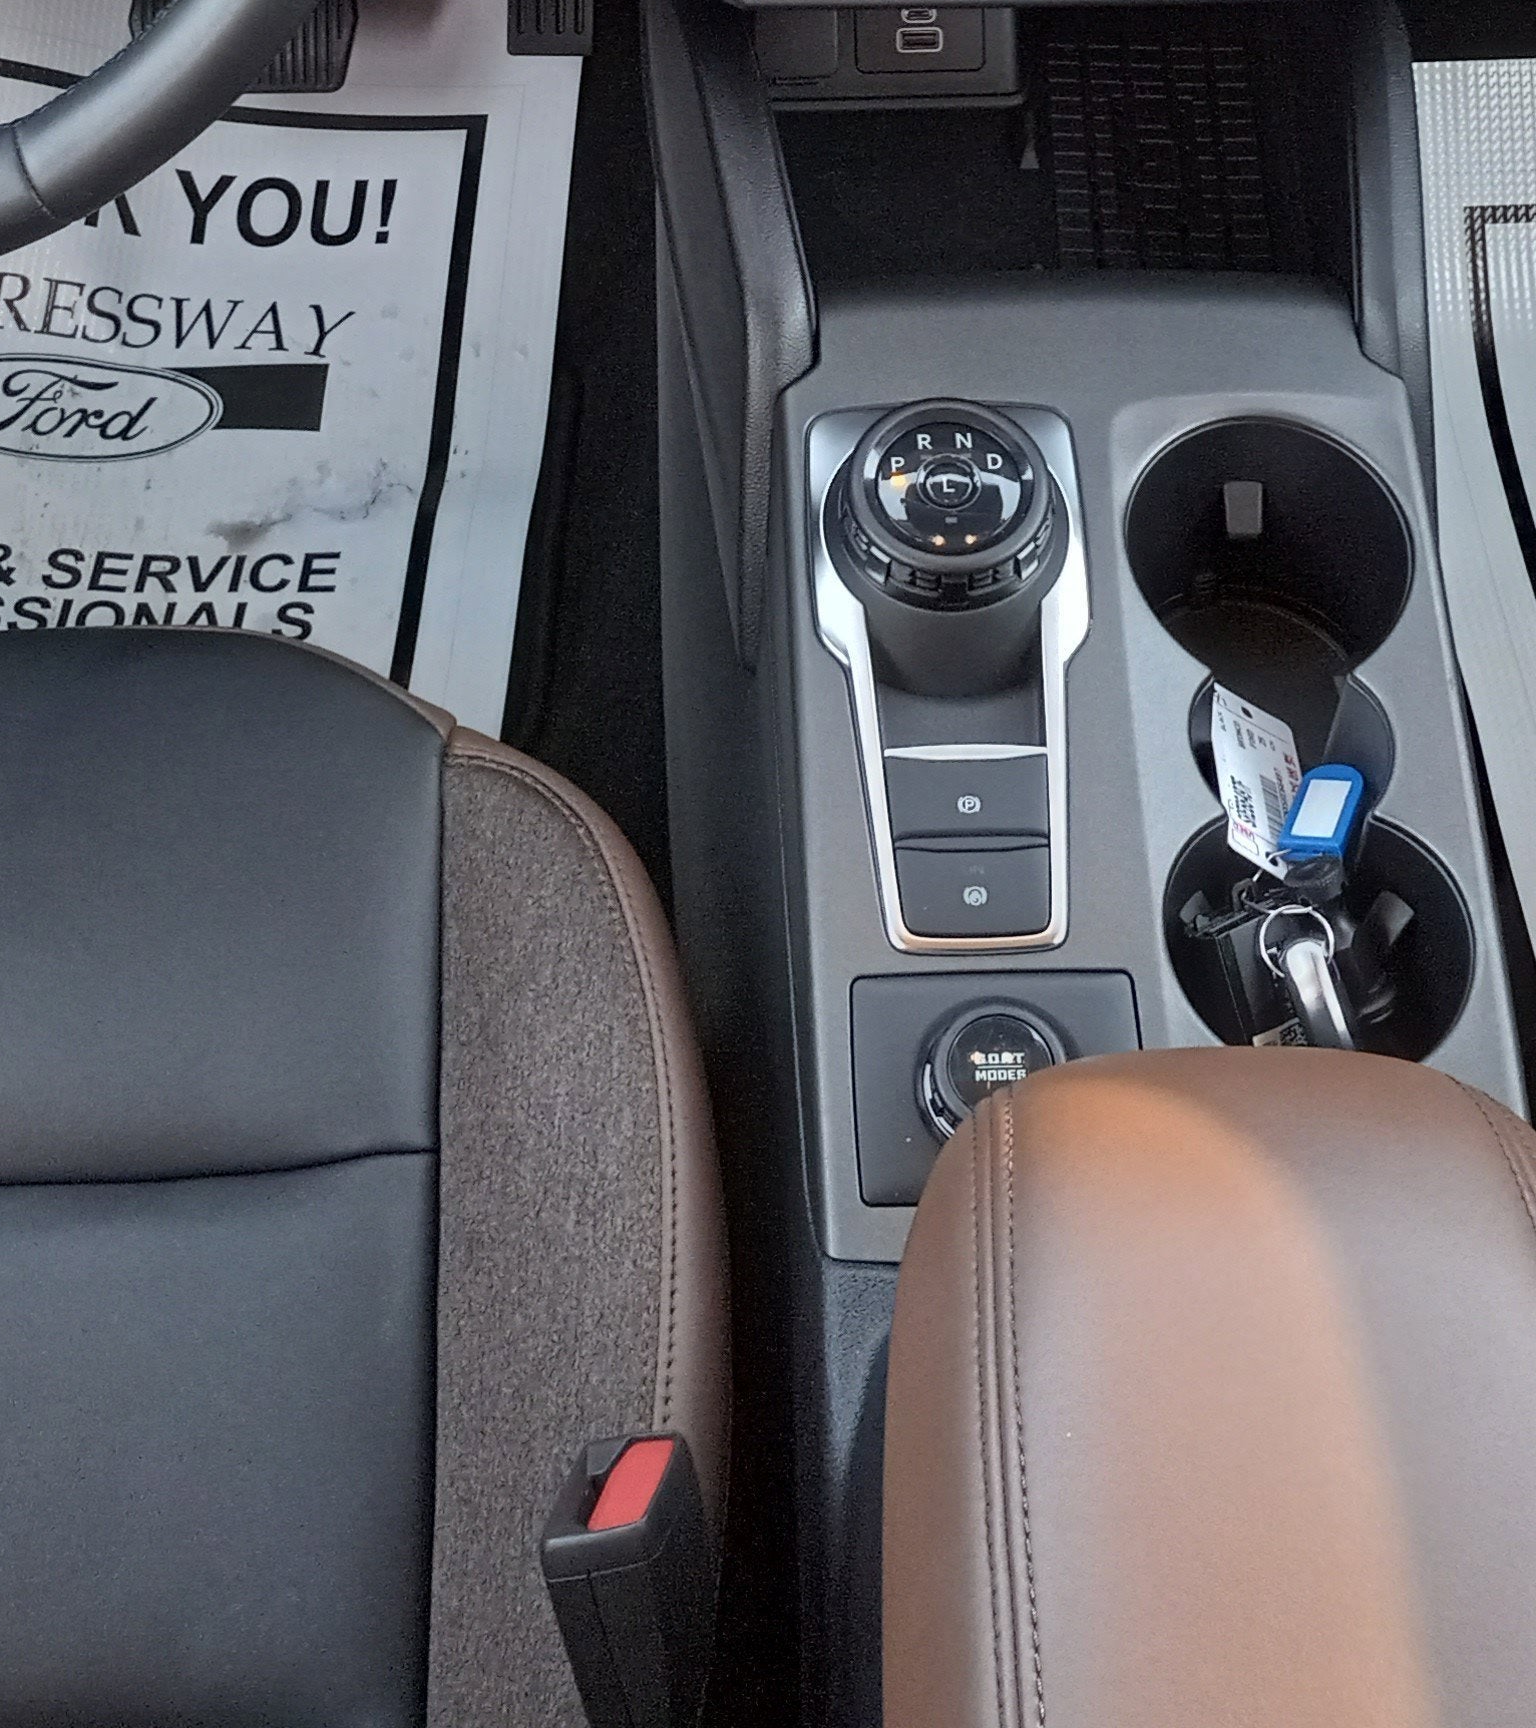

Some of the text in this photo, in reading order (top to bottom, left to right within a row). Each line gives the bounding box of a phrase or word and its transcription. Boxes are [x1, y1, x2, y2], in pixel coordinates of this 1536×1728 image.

[175, 168, 399, 248] YOU!
[890, 432, 1003, 474] P R N D
[942, 477, 956, 494] L
[41, 547, 342, 594] SERVICE
